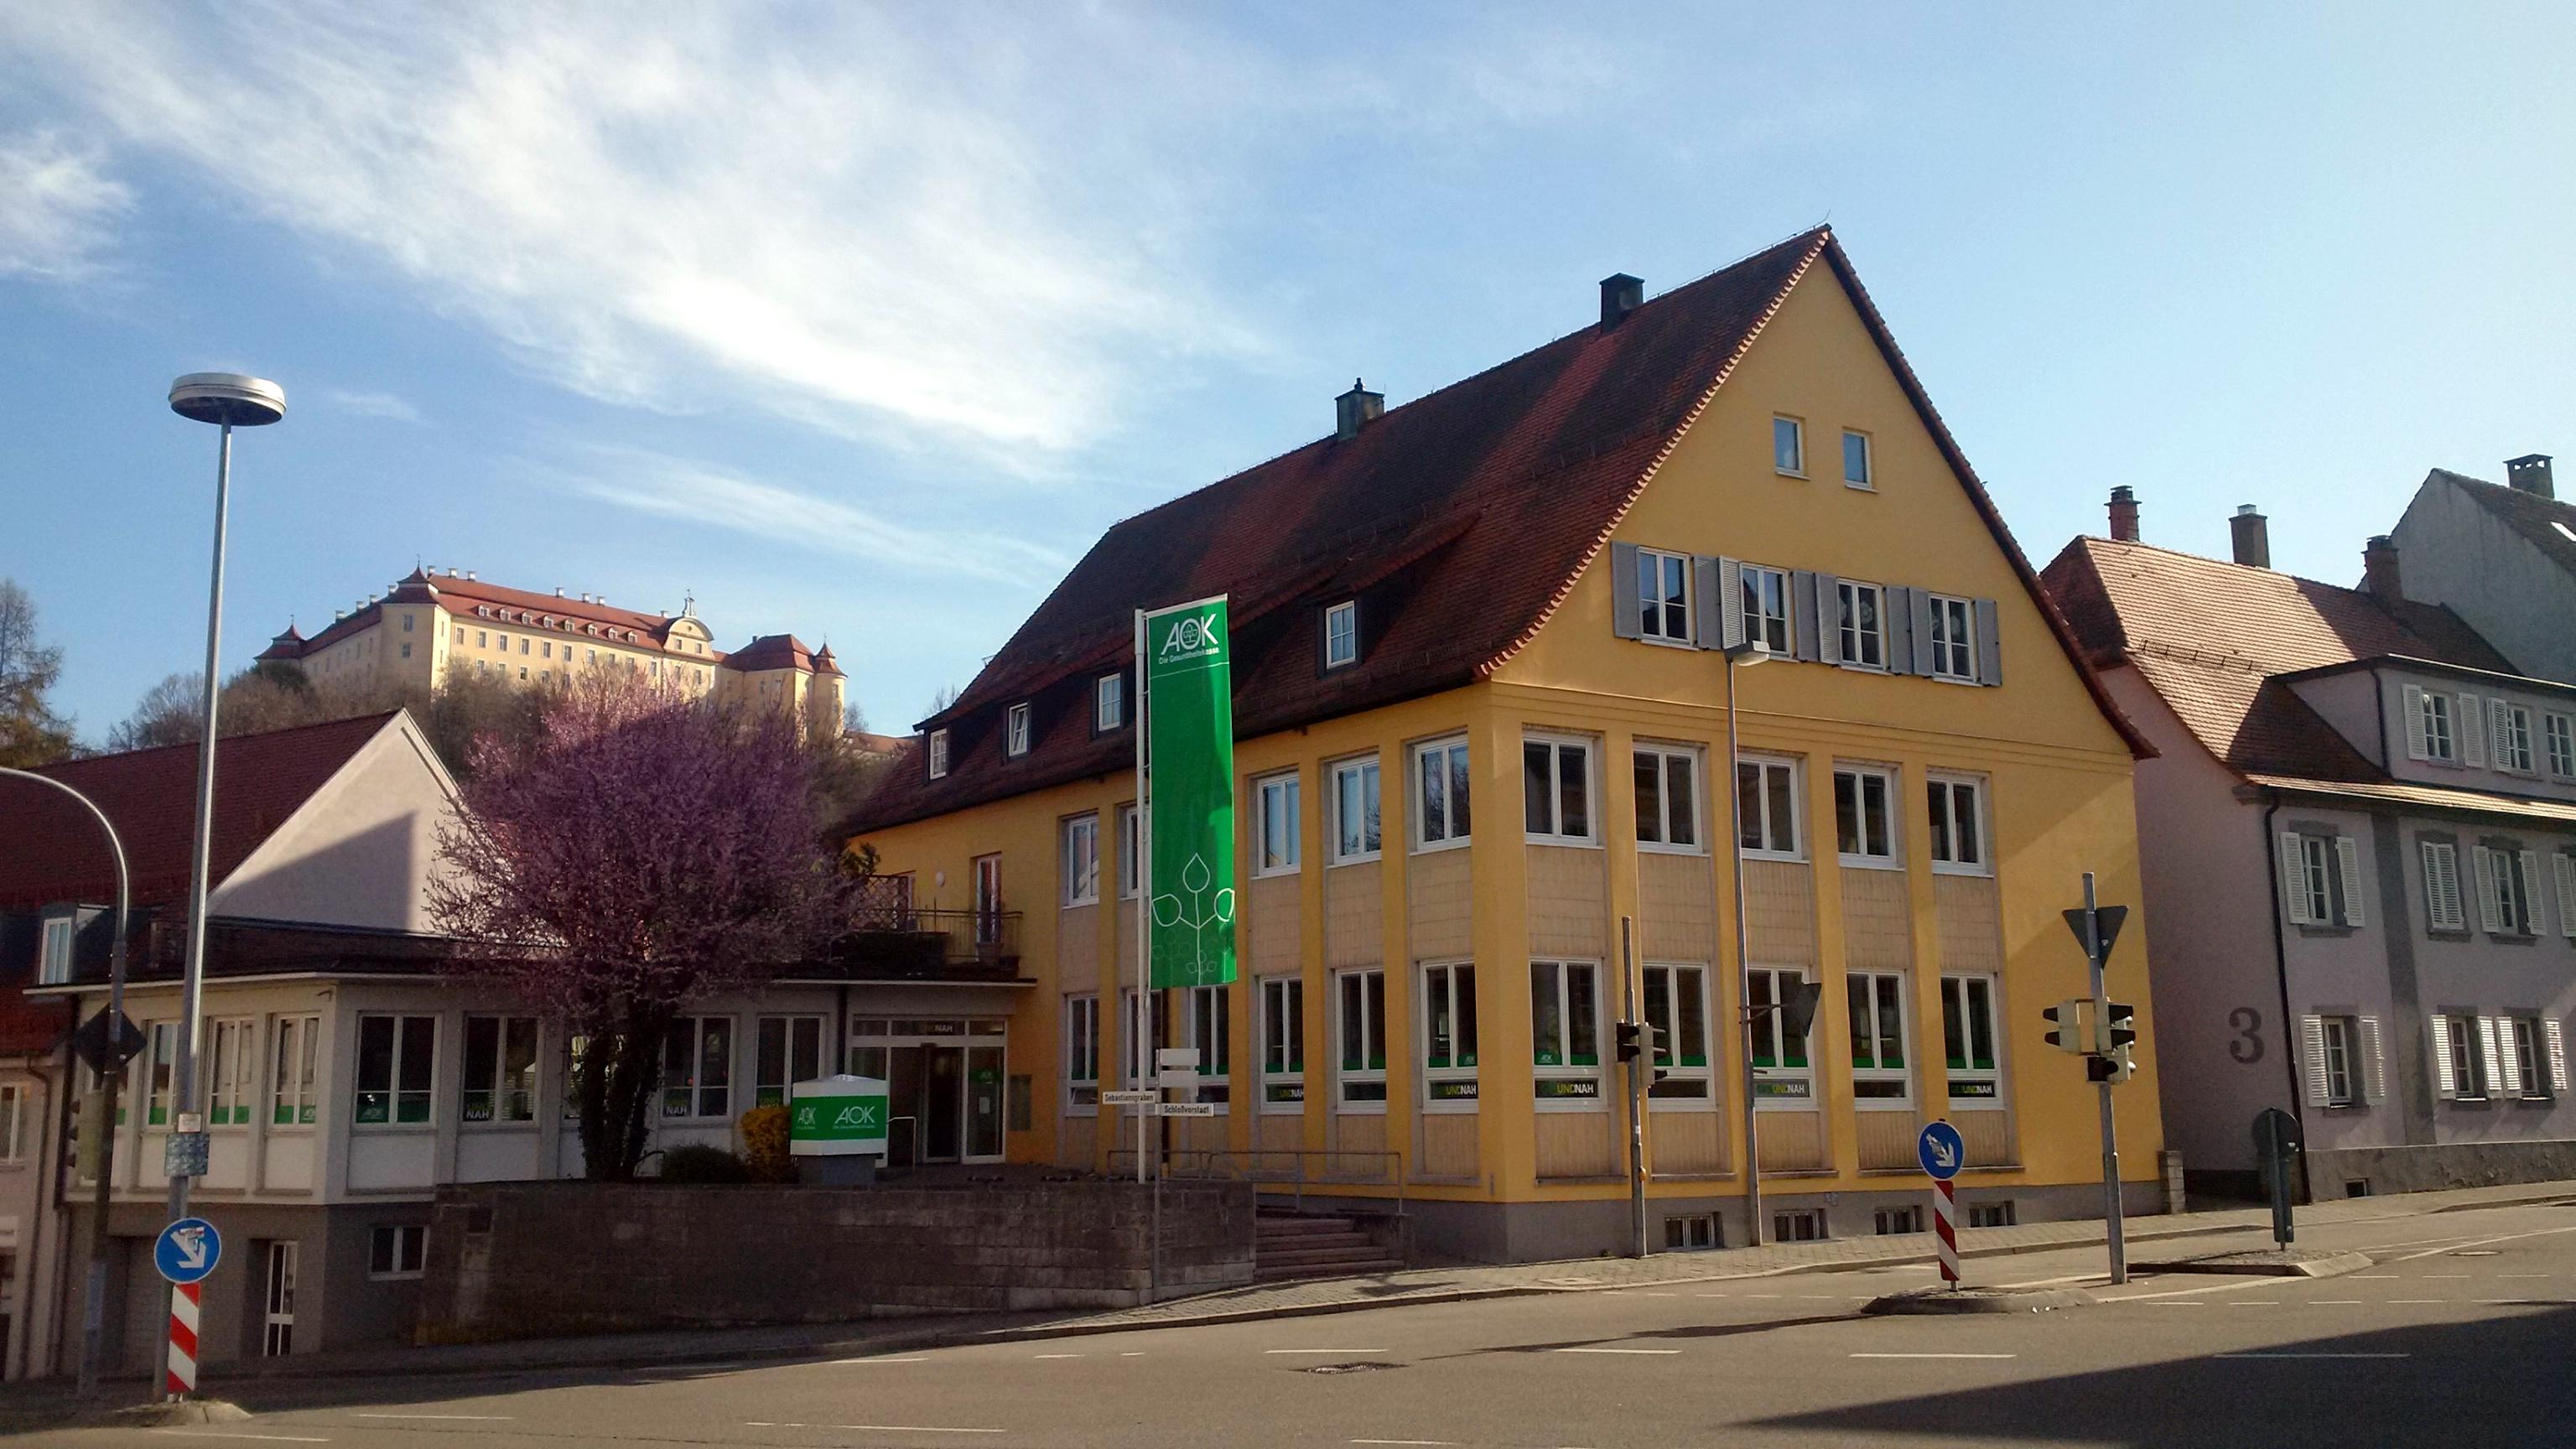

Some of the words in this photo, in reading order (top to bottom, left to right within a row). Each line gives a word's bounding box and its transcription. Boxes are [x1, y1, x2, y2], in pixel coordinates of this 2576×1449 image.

[1161, 613, 1219, 655] AOK
[2229, 1006, 2265, 1064] 3
[466, 1109, 490, 1119] NAH
[797, 1107, 817, 1124] AOK
[834, 1106, 876, 1124] AOK
